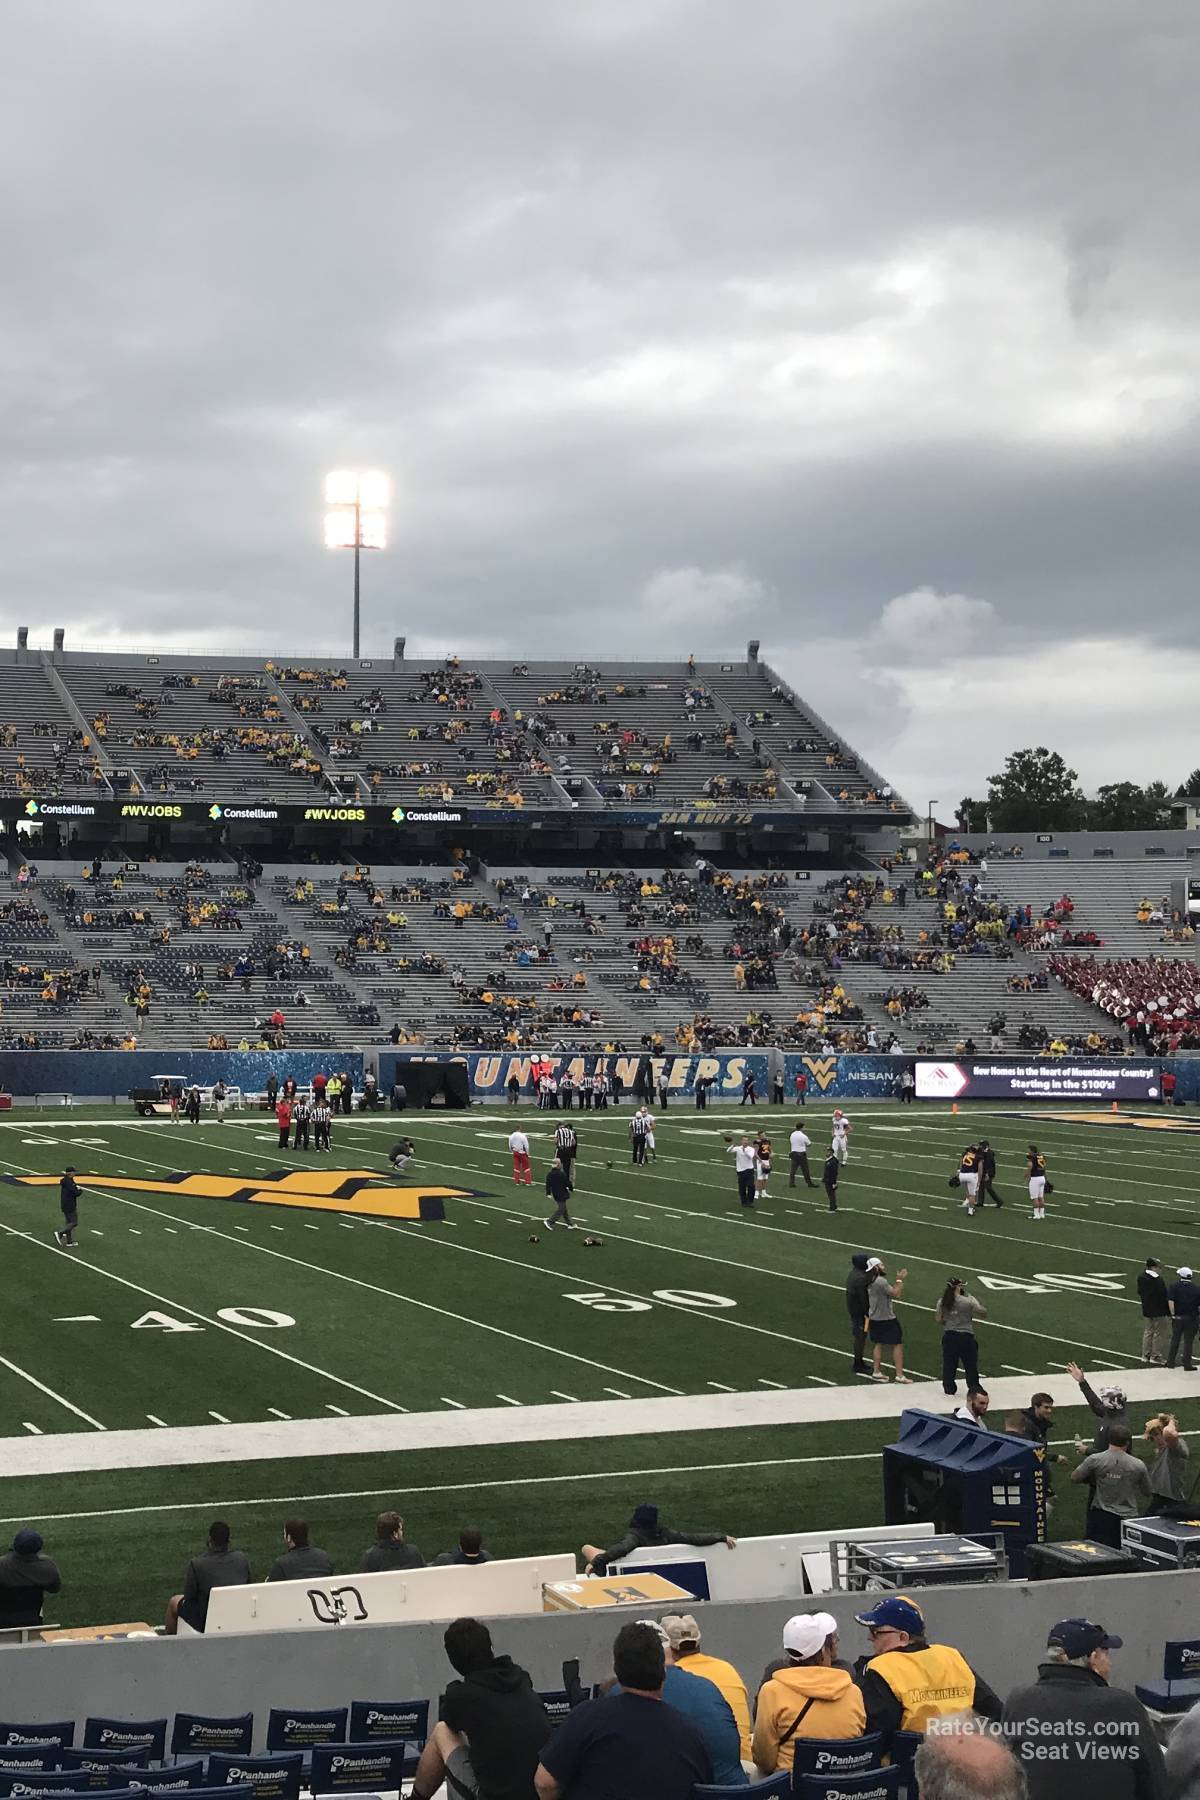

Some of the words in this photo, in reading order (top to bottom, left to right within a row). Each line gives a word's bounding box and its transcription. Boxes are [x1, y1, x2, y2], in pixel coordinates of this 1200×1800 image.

[39, 804, 95, 815] Constellium
[121, 806, 182, 818] #WVJOBS
[223, 808, 278, 819] Constellium
[304, 809, 366, 821] #WVJOBS
[406, 811, 461, 822] Constellium
[847, 1072, 894, 1081] NISSAN
[973, 1066, 990, 1076] New
[991, 1067, 1016, 1076] Homes
[1017, 1067, 1025, 1076] in
[1026, 1067, 1039, 1076] the
[1040, 1067, 1062, 1077] Heart
[1062, 1068, 1071, 1077] of
[1071, 1068, 1120, 1078] Mountaineer
[1120, 1068, 1154, 1079] Country!
[1010, 1079, 1050, 1090] Starting
[1051, 1080, 1061, 1089] in
[1062, 1079, 1080, 1089] the
[377, 1712, 419, 1721] Panhandle
[201, 1727, 244, 1735] Panhandle
[17, 1735, 62, 1745] Panhandle
[111, 1732, 155, 1742] Panhandle
[343, 1756, 392, 1767] Panhandle
[830, 1752, 874, 1765] Panhandle
[240, 1770, 289, 1779] Panhandle
[838, 1787, 888, 1800] Panhandle
